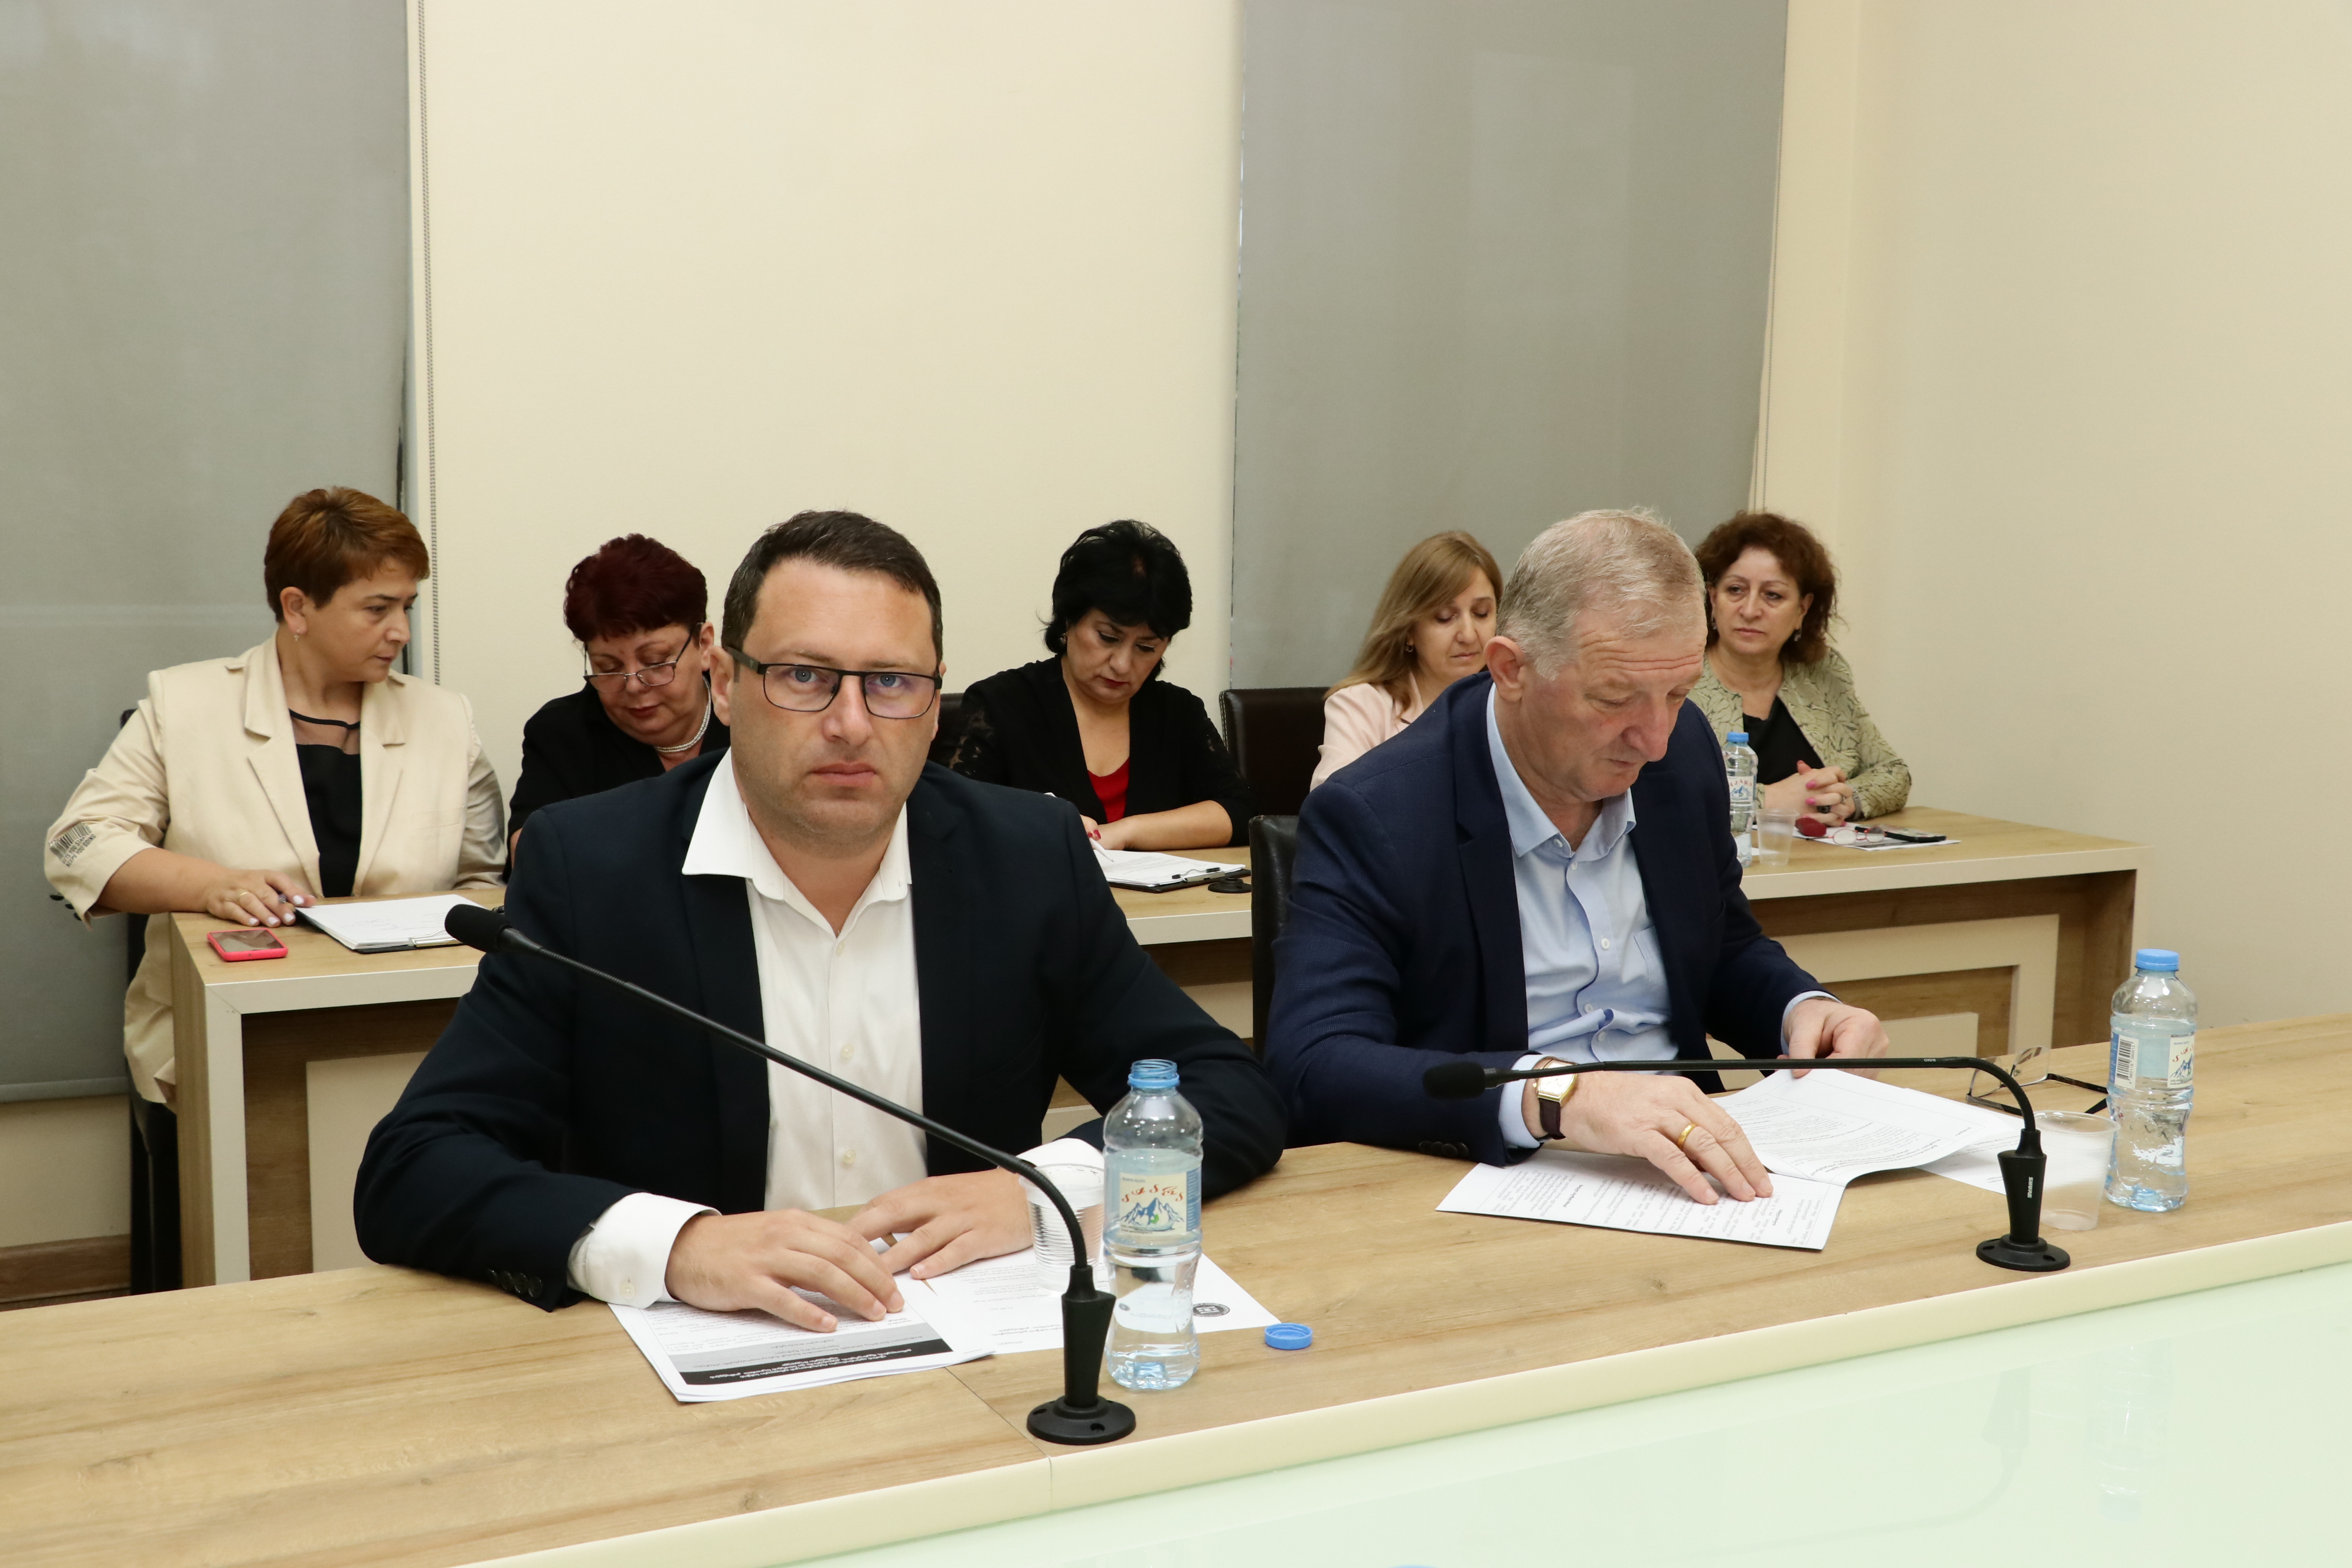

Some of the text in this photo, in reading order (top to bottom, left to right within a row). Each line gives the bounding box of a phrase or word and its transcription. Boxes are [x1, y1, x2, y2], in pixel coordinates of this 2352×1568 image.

[68, 845, 77, 854] YOU
[76, 846, 85, 854] YOU
[83, 834, 96, 847] GOING
